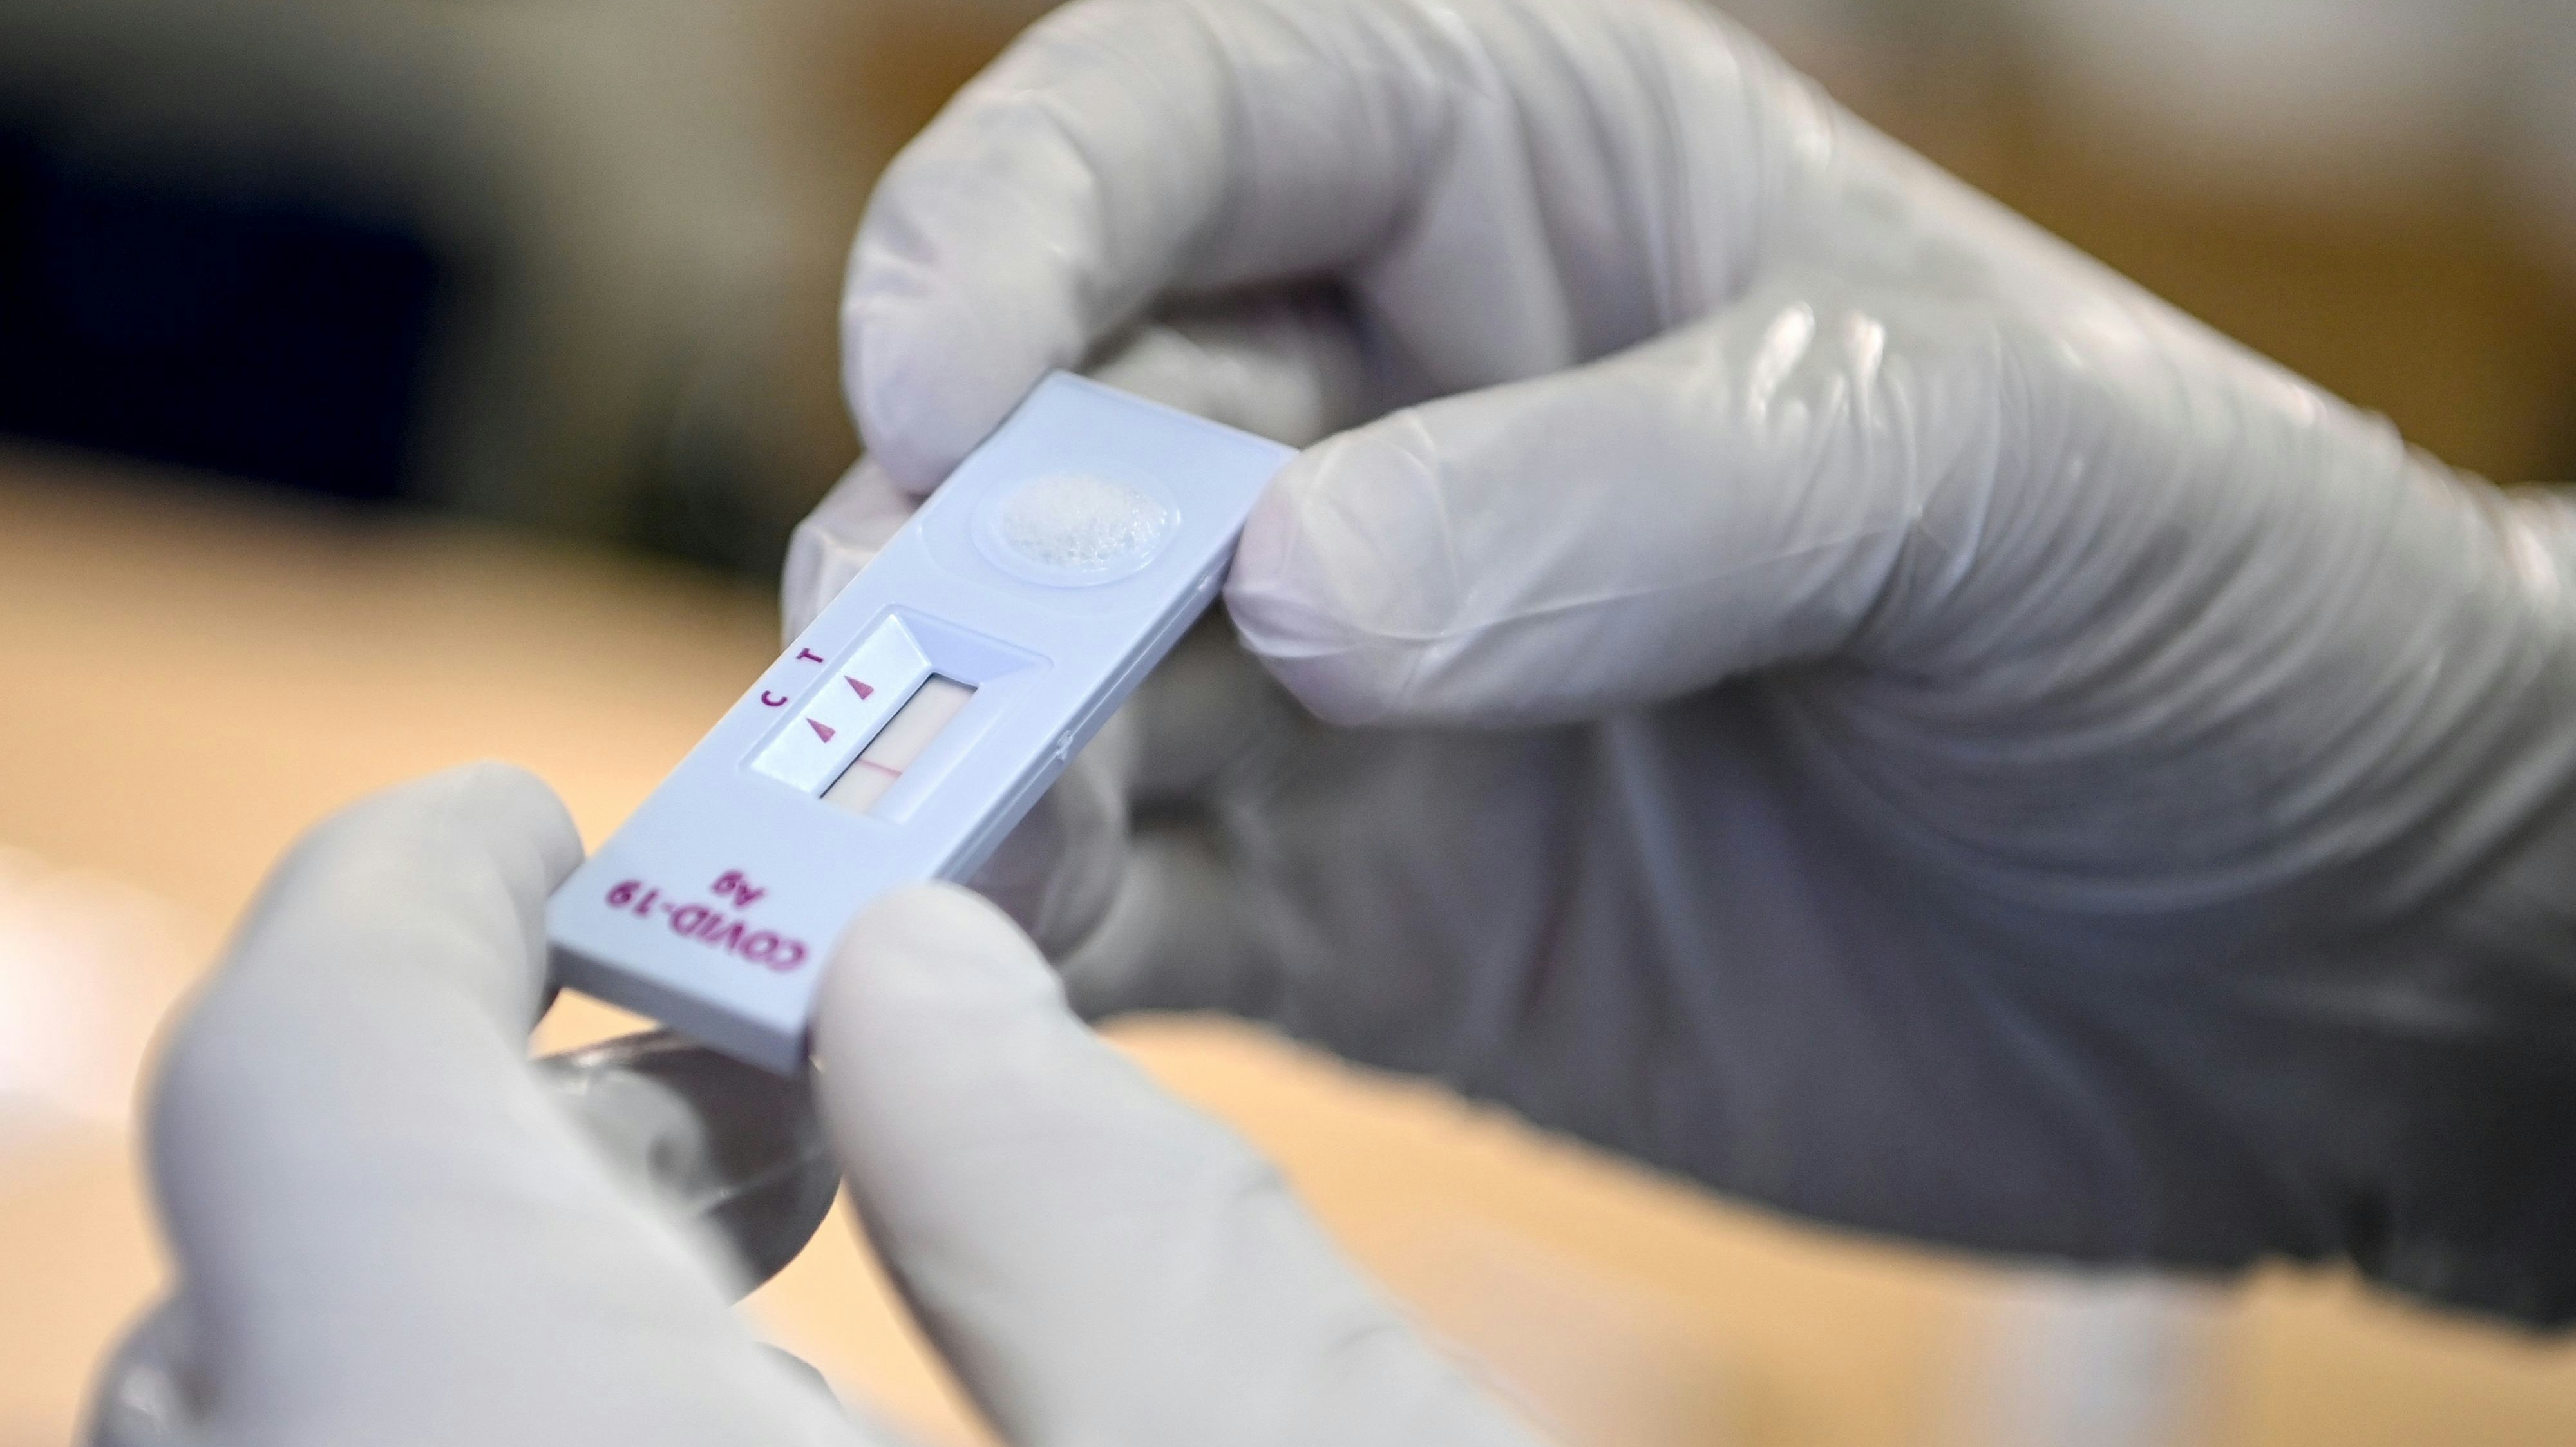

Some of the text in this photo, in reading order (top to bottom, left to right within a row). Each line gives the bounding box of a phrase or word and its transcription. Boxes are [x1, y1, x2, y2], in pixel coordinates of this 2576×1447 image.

[761, 647, 824, 707] C T
[712, 870, 766, 909] Ag
[605, 880, 808, 971] COVID-19
